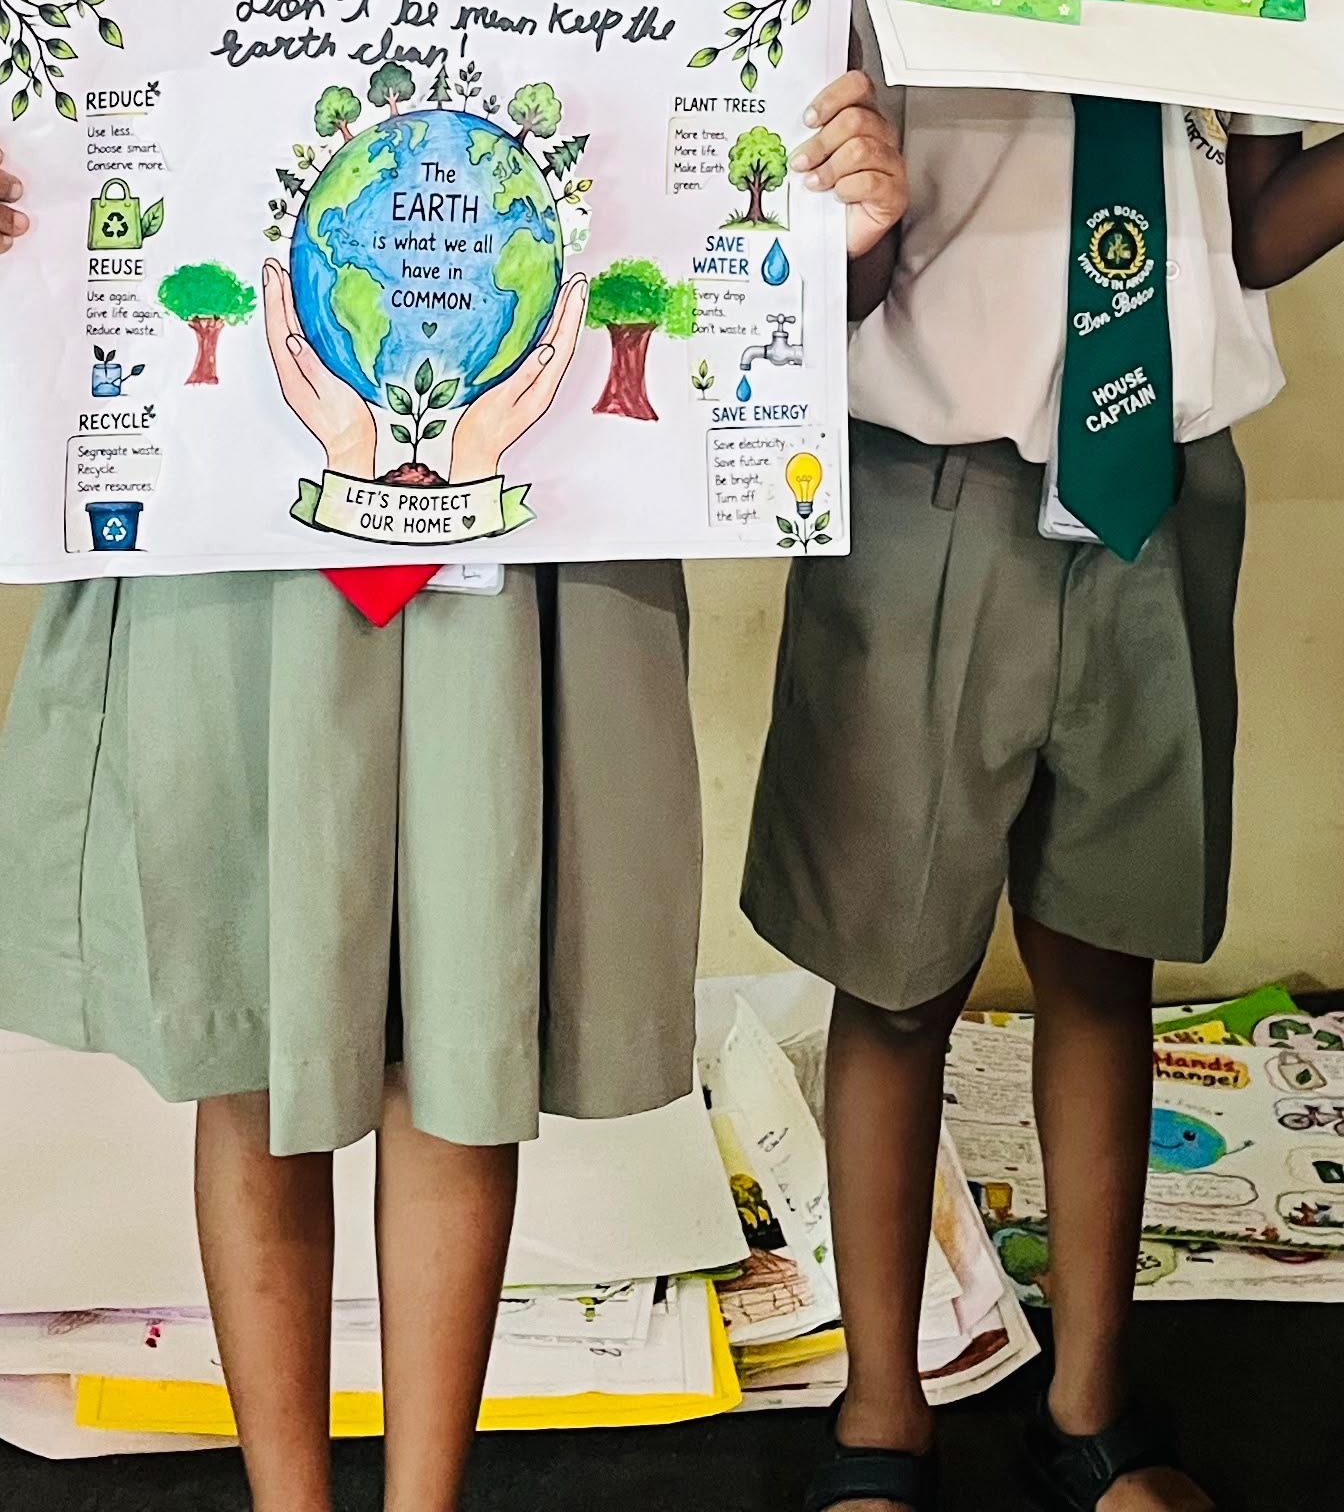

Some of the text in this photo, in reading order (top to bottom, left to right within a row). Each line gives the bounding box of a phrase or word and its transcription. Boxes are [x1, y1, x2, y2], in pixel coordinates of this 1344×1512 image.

[450, 6, 538, 35] mean
[620, 6, 676, 44] the
[86, 89, 155, 110] REDUCE
[674, 97, 766, 114] PLANT TREES
[87, 126, 106, 138] Use
[1183, 110, 1224, 166] VIRTUS
[87, 143, 122, 154] Choose
[87, 161, 133, 171] Conserve
[421, 161, 456, 184] The
[392, 191, 479, 224] EARTH
[372, 234, 493, 254] is what we all
[705, 236, 745, 253] SAVE
[89, 258, 143, 276] REUSE
[401, 262, 463, 280] have in
[693, 257, 750, 276] WATER
[1092, 366, 1148, 406] HOUSE
[712, 404, 808, 423] SAVE ENERGY
[1086, 383, 1156, 433] CAPTAIN
[79, 413, 150, 431] RECYCLE
[346, 488, 471, 511] LET'S PROTECT
[359, 512, 452, 534] OUR HOME
